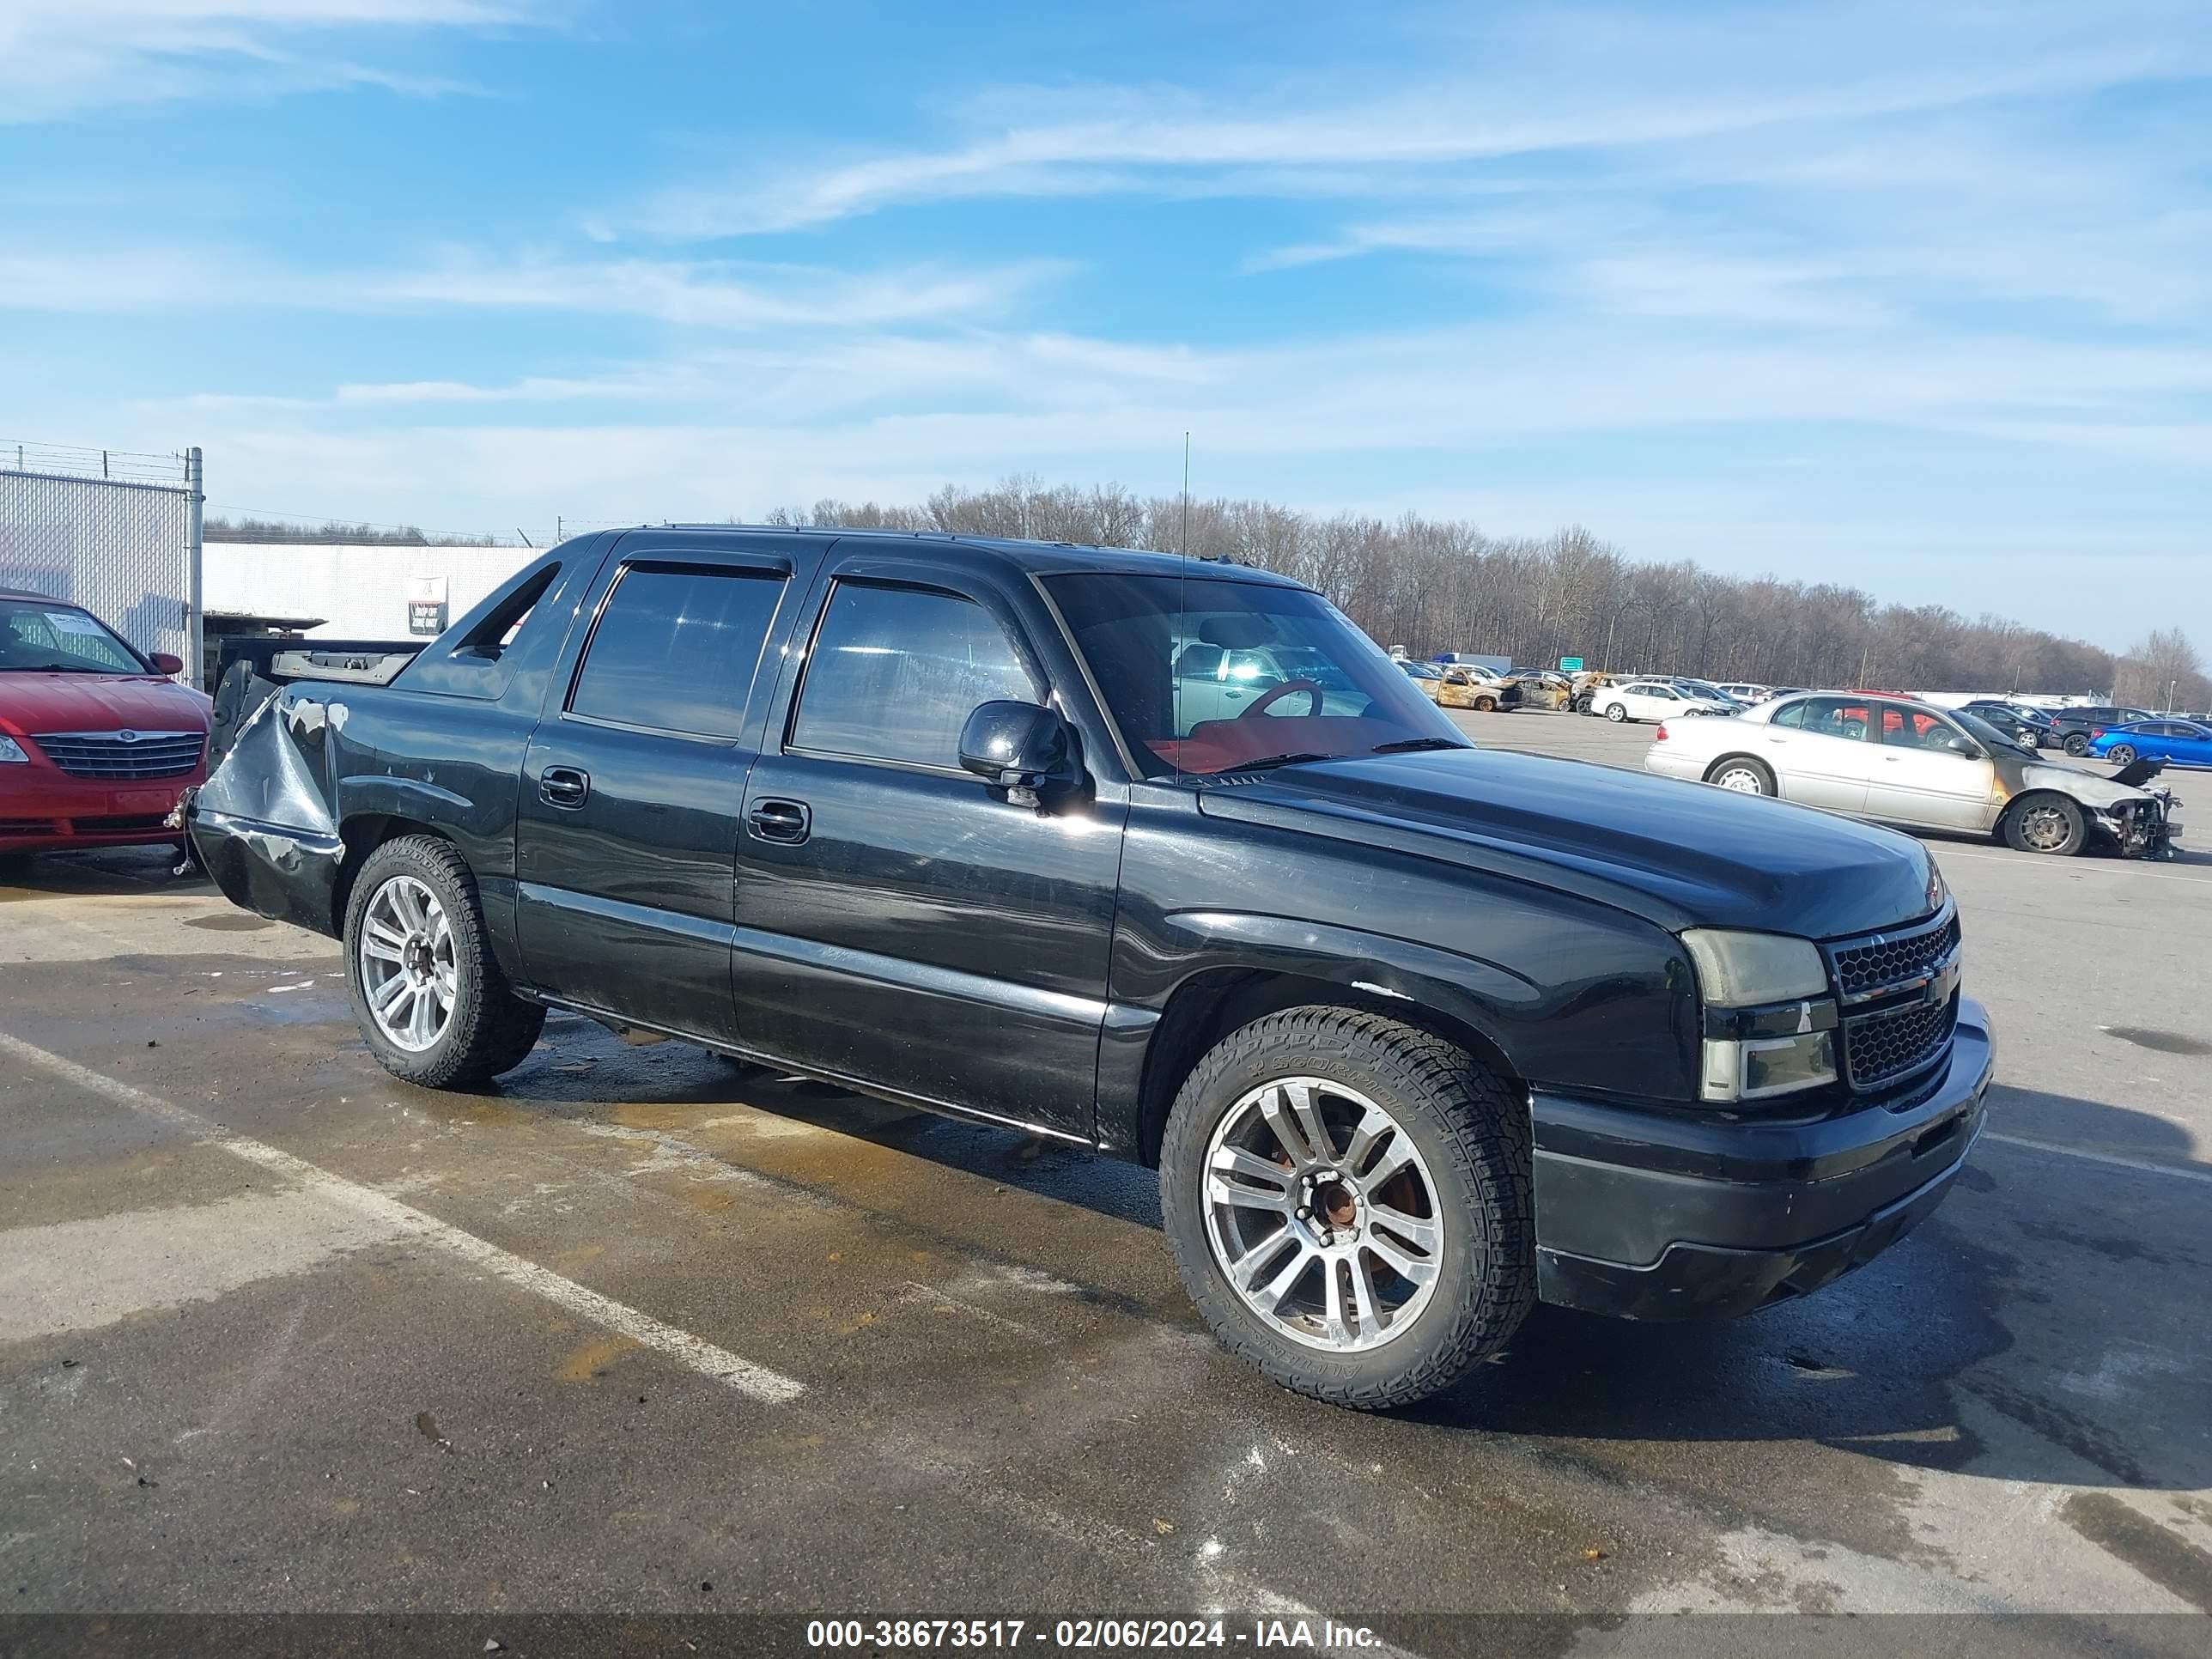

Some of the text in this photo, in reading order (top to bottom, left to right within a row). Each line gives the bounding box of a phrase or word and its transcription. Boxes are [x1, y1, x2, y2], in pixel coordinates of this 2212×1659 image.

[428, 607, 438, 617] OFF
[412, 617, 438, 628] ZONE ONLY
[1273, 1054, 1416, 1122] SCORPION
